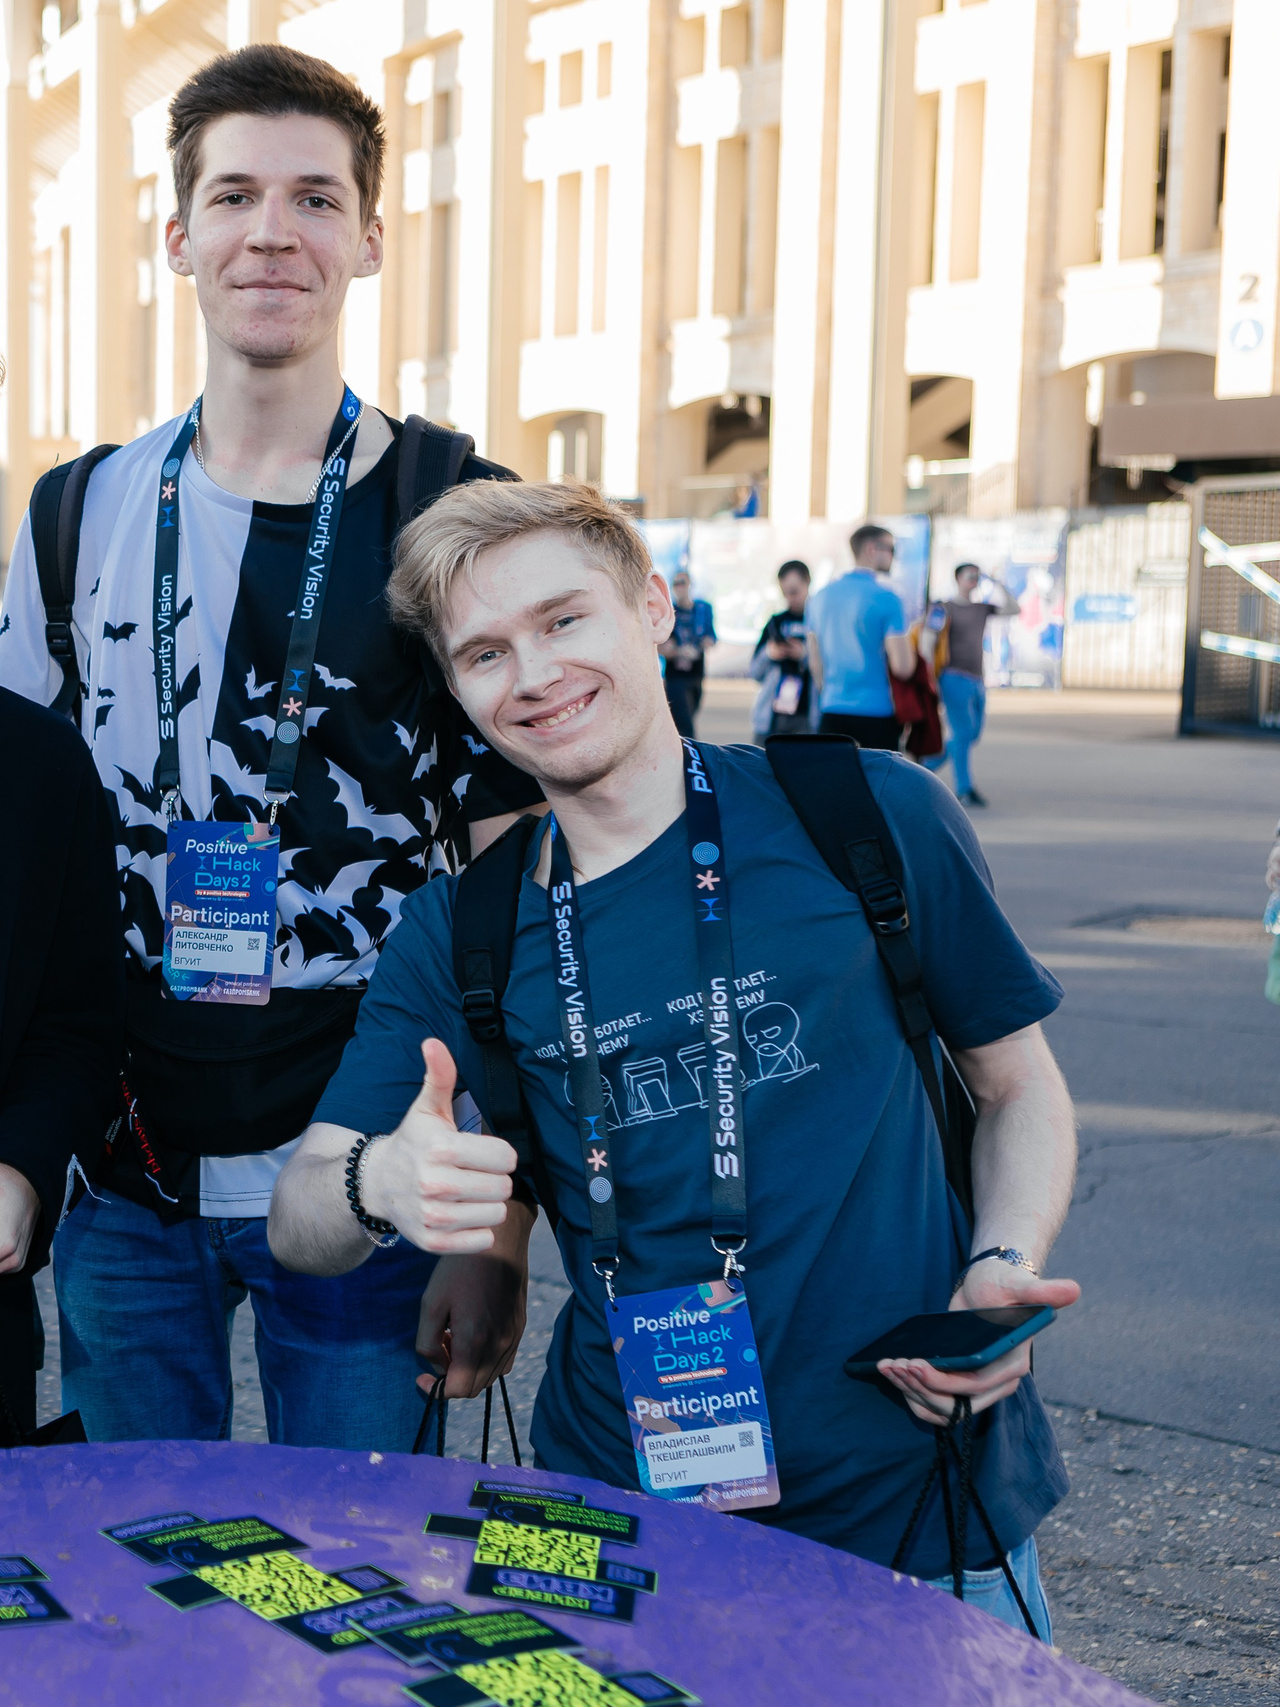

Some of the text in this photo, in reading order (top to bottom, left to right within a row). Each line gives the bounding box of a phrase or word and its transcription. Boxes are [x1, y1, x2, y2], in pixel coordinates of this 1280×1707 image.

[299, 480, 340, 620] Security Vision
[157, 574, 174, 714] Security Vision
[185, 839, 248, 854] Positive
[212, 857, 261, 872] Hack
[195, 872, 251, 890] Days 2
[170, 905, 269, 928] Participant
[175, 931, 229, 942] АЛЕКСАНДР
[174, 942, 234, 953] ЛИТОВЧЕНКО
[174, 956, 202, 966] ВГУИТ
[554, 905, 588, 1058] Security Vision
[666, 994, 699, 1014] КОД
[708, 977, 738, 1146] Security Vision
[633, 1309, 711, 1334] Positive
[671, 1324, 734, 1349] Hack
[653, 1346, 726, 1372] Days 2
[633, 1386, 760, 1421] Participant
[648, 1434, 711, 1451] ВЛАДИСЛАВ
[650, 1443, 736, 1464] ТКЕШЕЛАШВИЛИ
[655, 1470, 688, 1484] ВГУИТ
